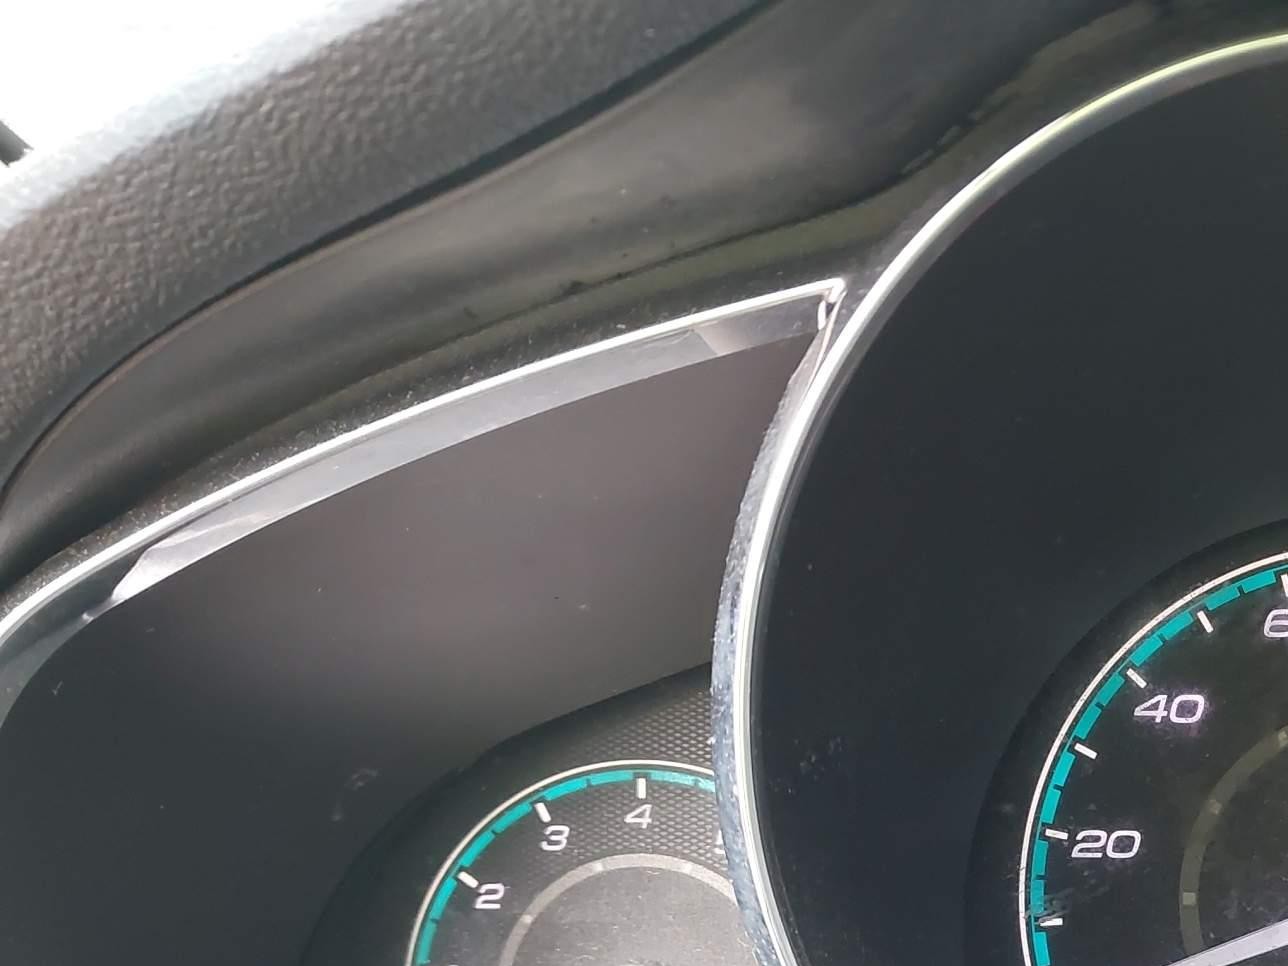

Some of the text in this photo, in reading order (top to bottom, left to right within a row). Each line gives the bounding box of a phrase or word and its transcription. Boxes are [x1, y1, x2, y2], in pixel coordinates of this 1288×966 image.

[1133, 694, 1205, 724] 40
[624, 803, 653, 829] 4
[541, 825, 570, 851] 3
[1071, 829, 1142, 859] 20
[475, 883, 505, 910] 2
